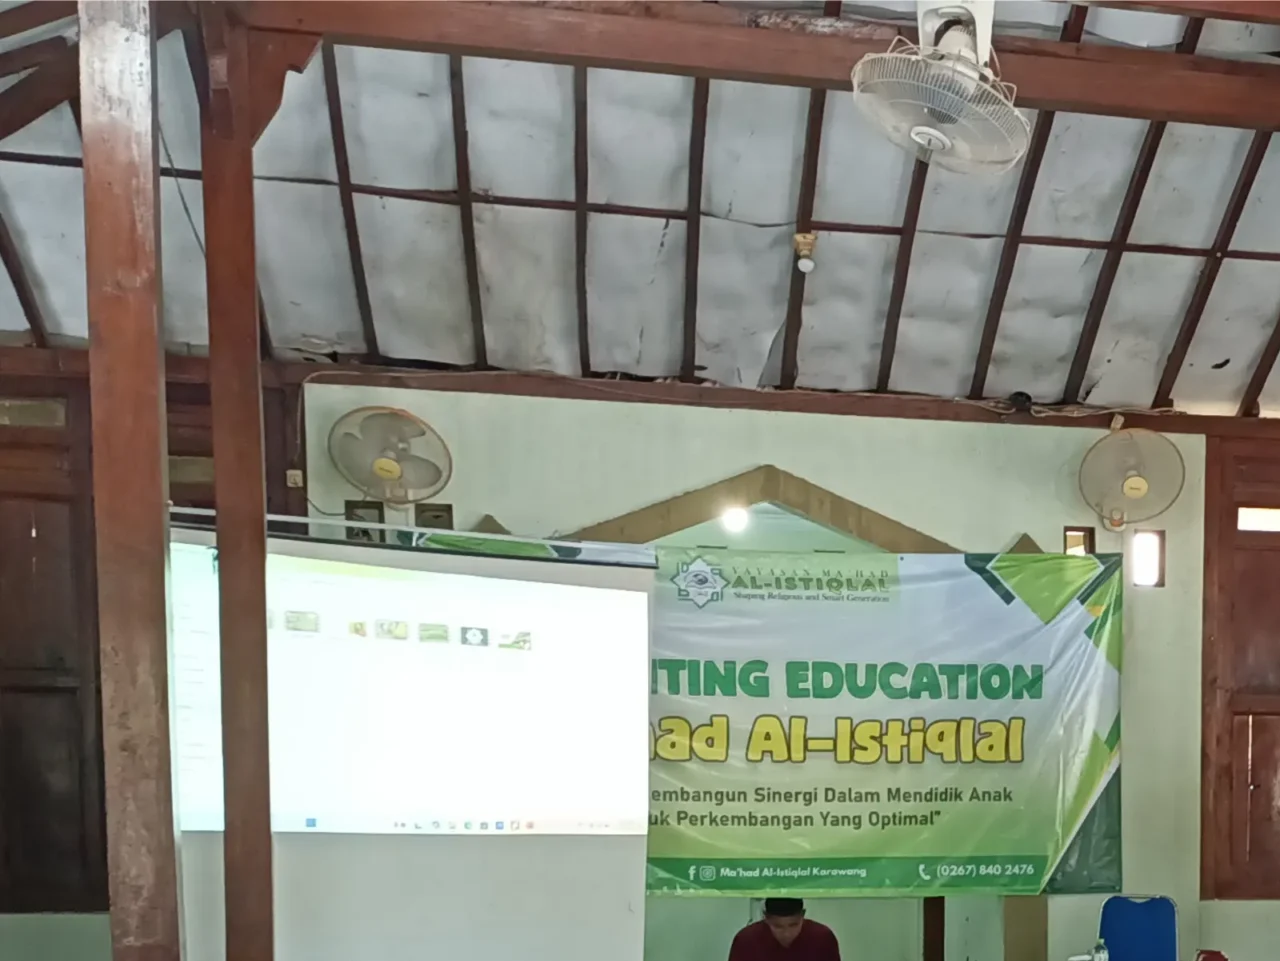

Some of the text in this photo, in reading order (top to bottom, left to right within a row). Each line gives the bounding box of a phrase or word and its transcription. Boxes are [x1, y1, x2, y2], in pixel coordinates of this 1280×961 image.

[731, 575, 890, 595] AL-ISTIQLAL
[651, 658, 1044, 700] TING EDUCATION
[649, 713, 1026, 765] ad Al-Istiqlal
[754, 787, 818, 806] Sinergi
[824, 787, 880, 803] Dalam
[887, 787, 963, 802] Mendidik
[969, 787, 1013, 802] Anak
[677, 810, 814, 830] Perkembangan
[819, 811, 862, 830] Yang
[762, 866, 811, 878] Al-Istiqlal
[937, 864, 1034, 878] (0267) 840 2476
